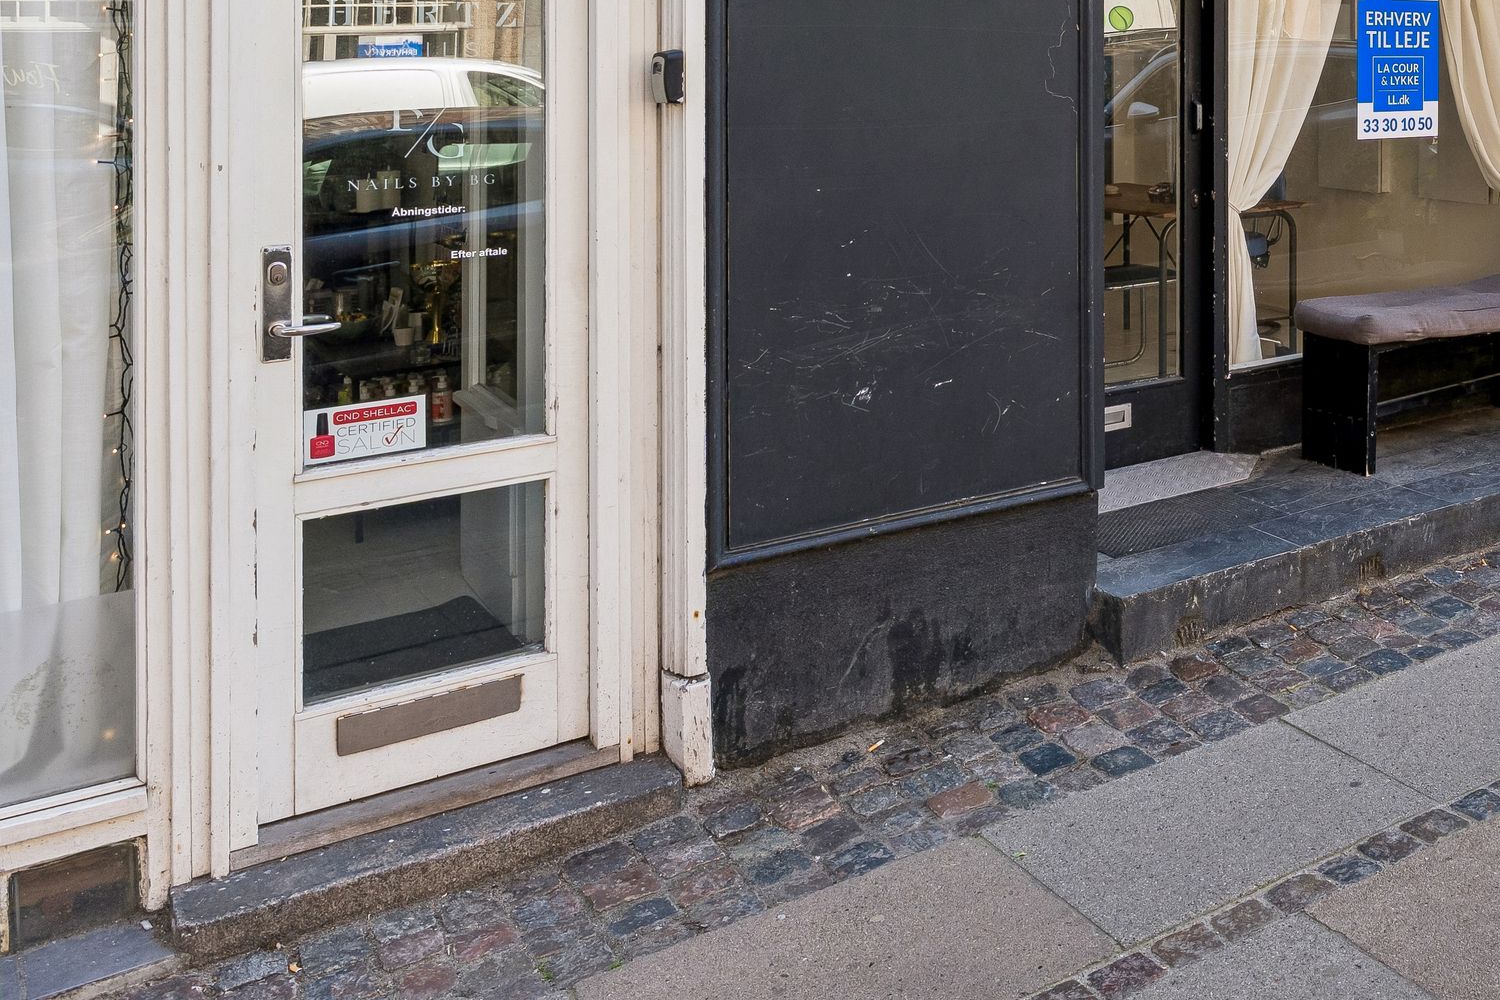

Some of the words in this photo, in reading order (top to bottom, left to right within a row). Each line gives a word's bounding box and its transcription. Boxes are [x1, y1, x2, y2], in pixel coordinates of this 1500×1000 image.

[1366, 10, 1431, 27] ERHVERV
[1366, 30, 1392, 48] TIL
[1395, 31, 1430, 48] LEJE
[1377, 64, 1390, 74] LA
[1392, 63, 1420, 73] COUR
[1380, 76, 1388, 86] &
[1390, 76, 1420, 86] LYKKE
[1387, 94, 1410, 106] LL.dk
[1364, 118, 1380, 133] 33
[1382, 118, 1398, 132] 30
[1401, 117, 1416, 132] 10
[1418, 116, 1433, 130] 50
[347, 177, 418, 192] NAILS
[432, 176, 457, 188] BY
[470, 173, 496, 186] BG
[450, 250, 477, 260] Efter
[478, 246, 508, 257] aftale
[336, 412, 360, 422] CND
[336, 418, 416, 438] CERTIFIED
[337, 429, 416, 455] SALON
